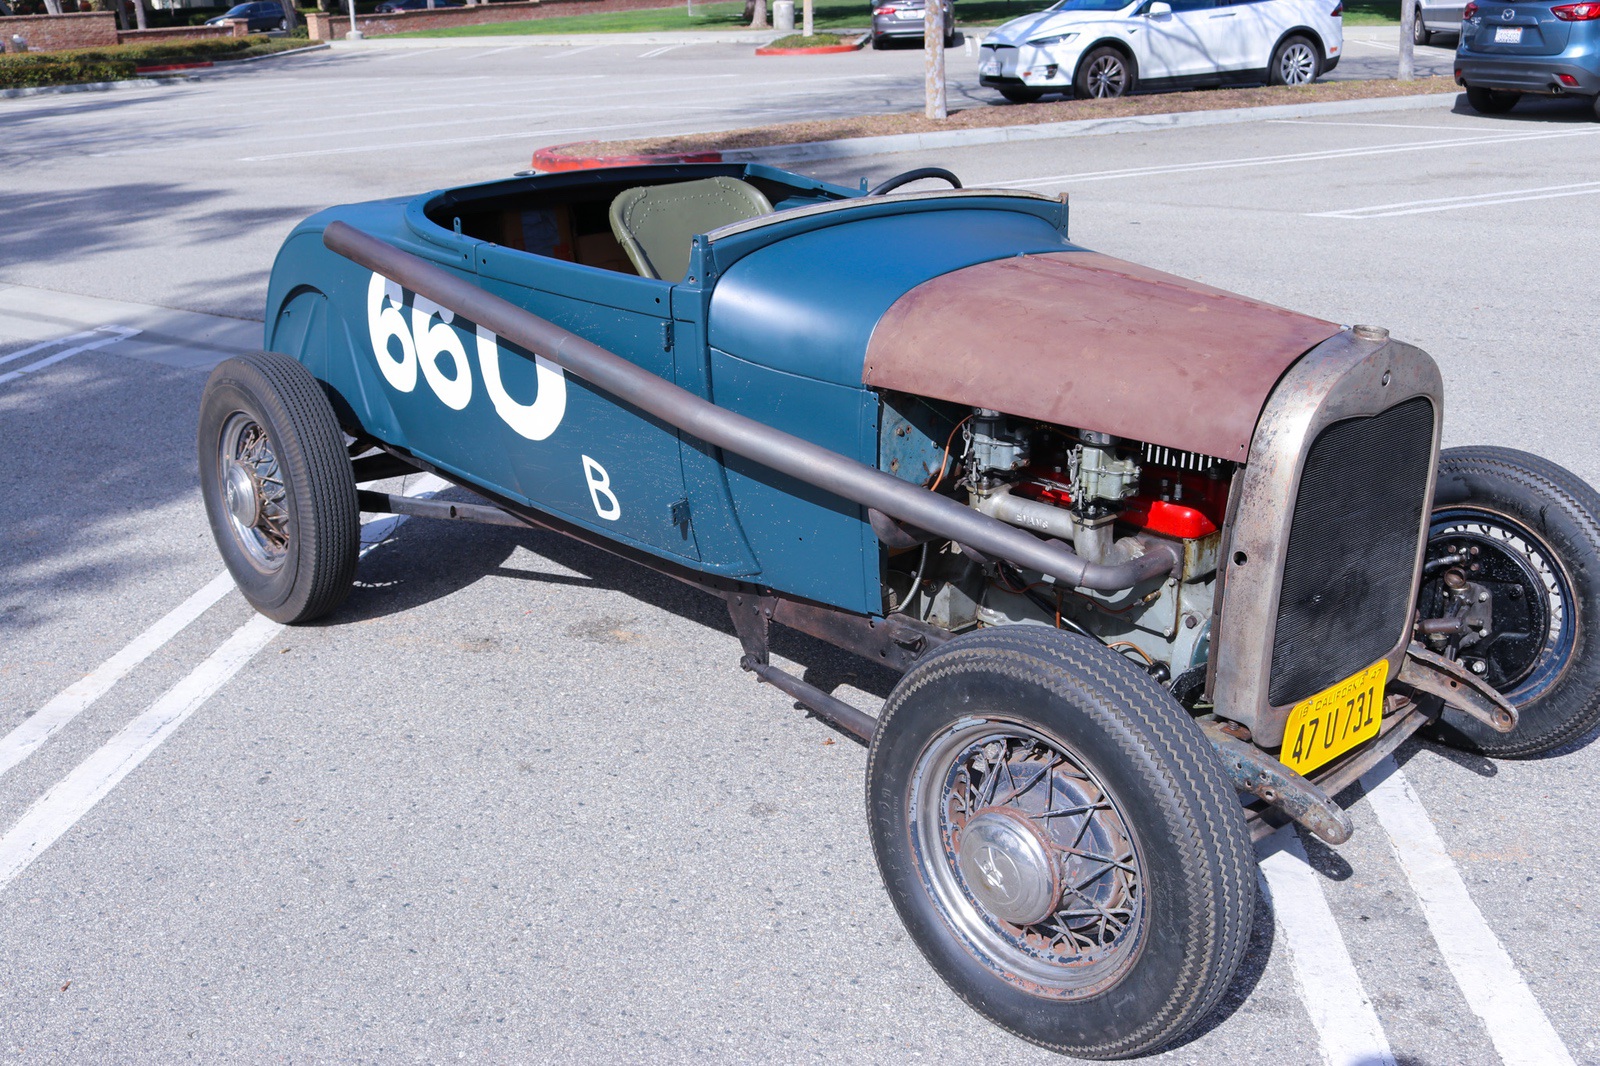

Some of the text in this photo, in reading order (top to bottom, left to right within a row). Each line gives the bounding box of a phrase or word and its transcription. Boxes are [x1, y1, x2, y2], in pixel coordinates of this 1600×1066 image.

[581, 454, 621, 521] B
[1016, 513, 1049, 529] EVANS
[1291, 686, 1375, 764] 47 U 731
[1298, 706, 1309, 720] 19
[1315, 676, 1365, 711] CALIFORNIA
